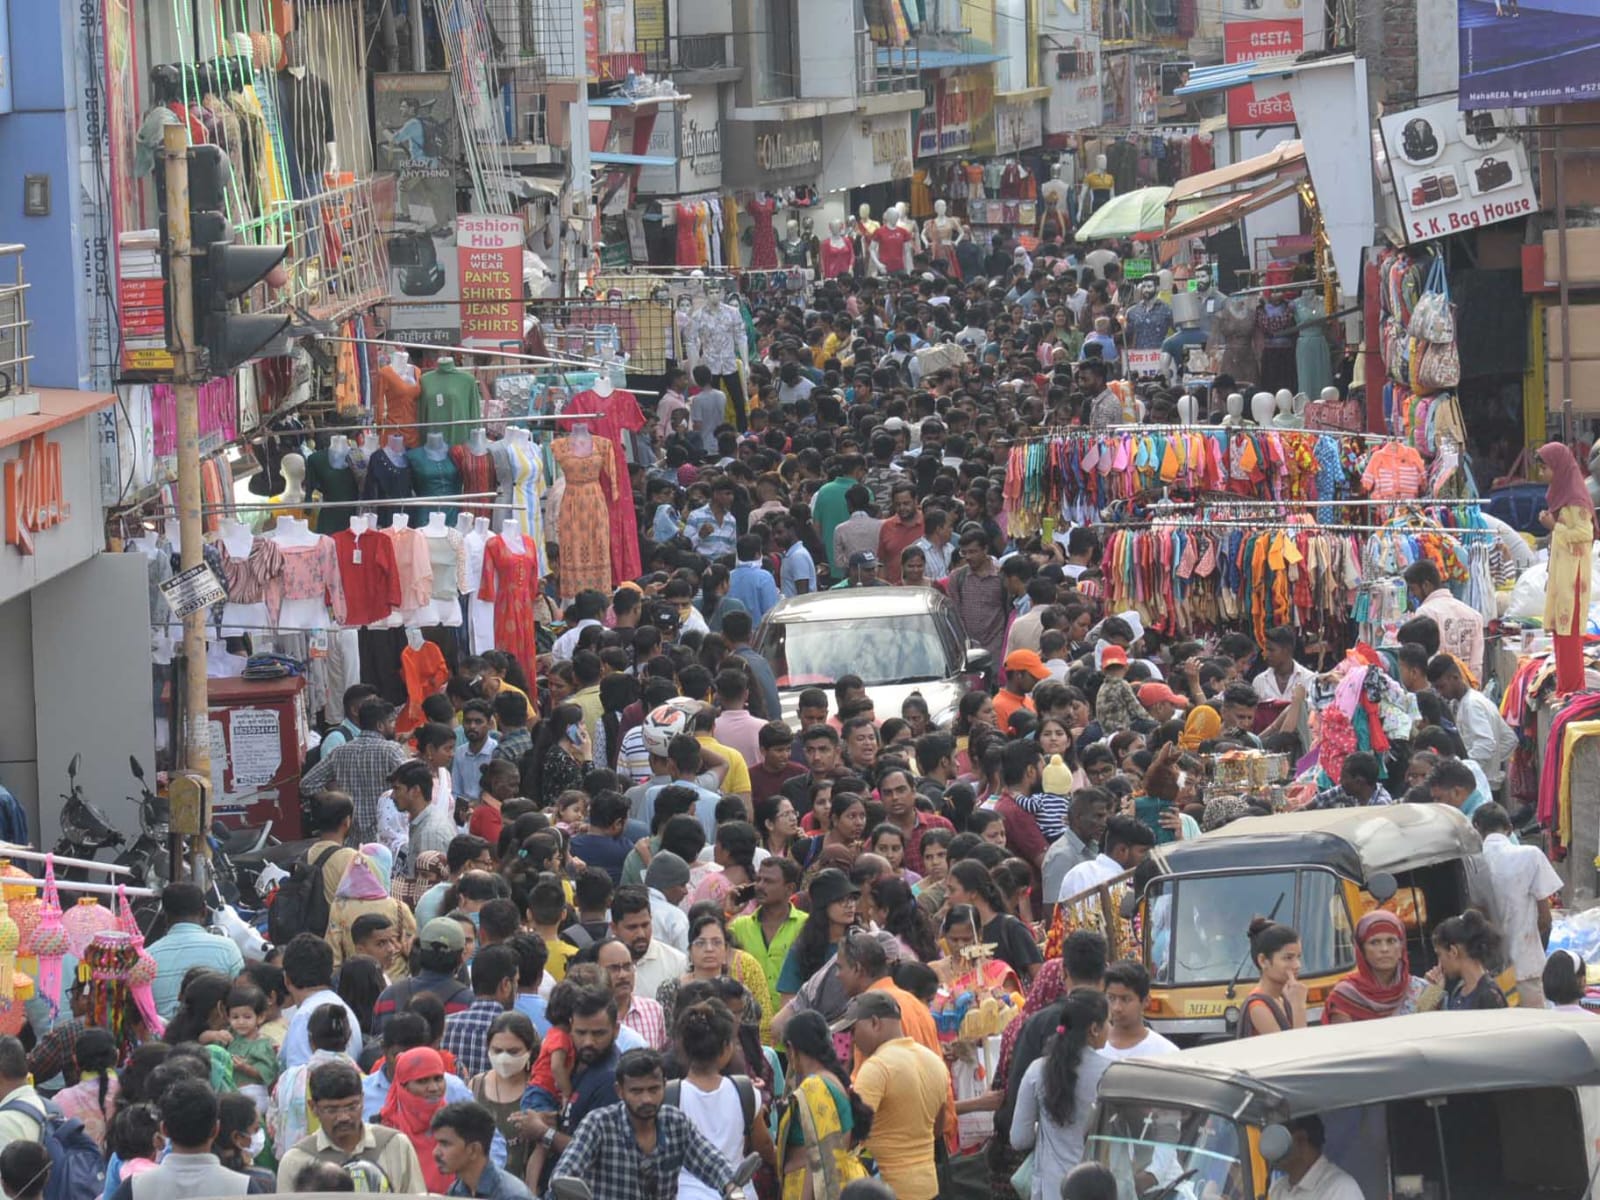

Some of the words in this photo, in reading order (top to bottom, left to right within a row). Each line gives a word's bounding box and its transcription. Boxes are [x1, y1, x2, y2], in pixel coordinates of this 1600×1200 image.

[1251, 31, 1292, 46] GEETA
[1513, 88, 1562, 99] Registration
[1413, 222, 1427, 238] S.
[1428, 217, 1445, 235] K.
[1448, 211, 1480, 232] Bag
[1482, 198, 1531, 222] House
[456, 219, 519, 232] Fashion
[471, 234, 504, 247] Hub
[470, 253, 504, 261] MENS
[470, 261, 504, 270] WEAR
[465, 271, 510, 283] PANTS
[463, 287, 512, 300] SHIRTS
[465, 303, 509, 316] JEANS
[1190, 1003, 1208, 1014] MH
